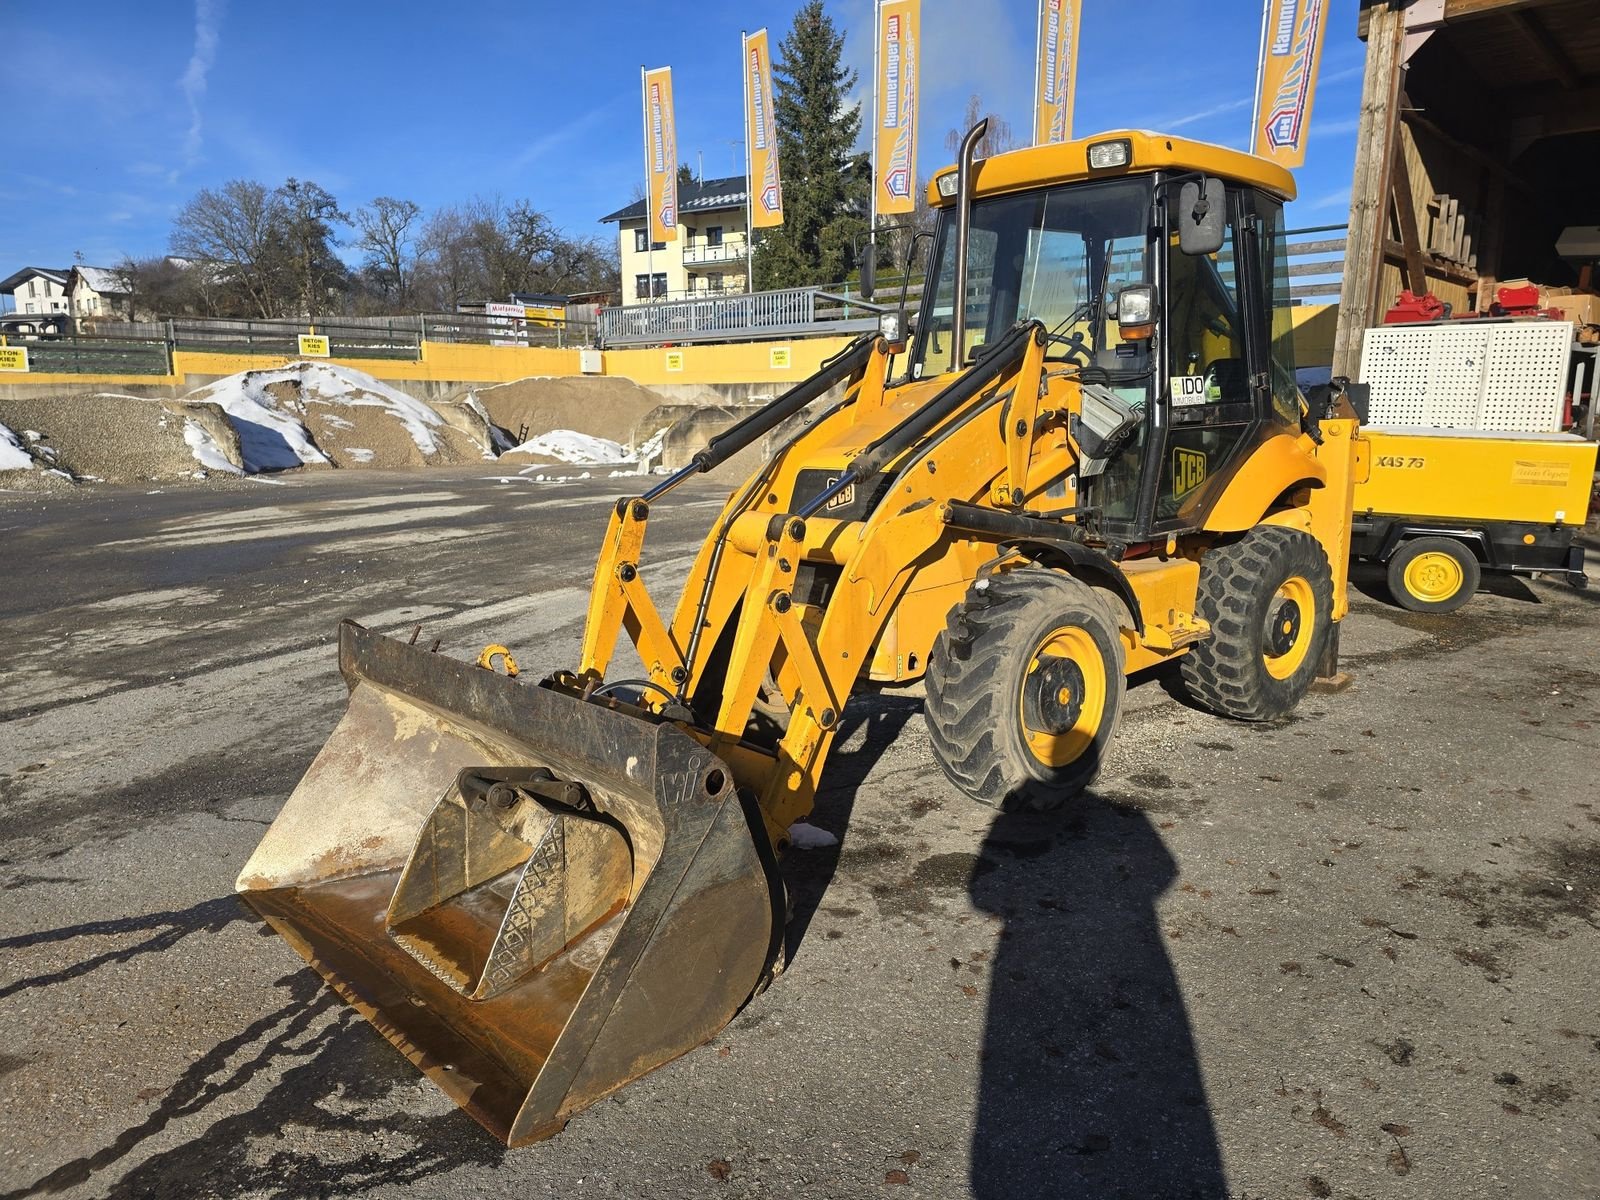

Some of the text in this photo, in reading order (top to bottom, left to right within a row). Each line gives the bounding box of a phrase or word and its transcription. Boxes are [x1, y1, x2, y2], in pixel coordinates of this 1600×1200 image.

[884, 16, 900, 128] Hammertinger Bau
[651, 104, 664, 173] Hammertinger
[492, 305, 523, 314] Mietservice
[1175, 453, 1204, 495] JCB
[1376, 456, 1425, 468] XAS 76
